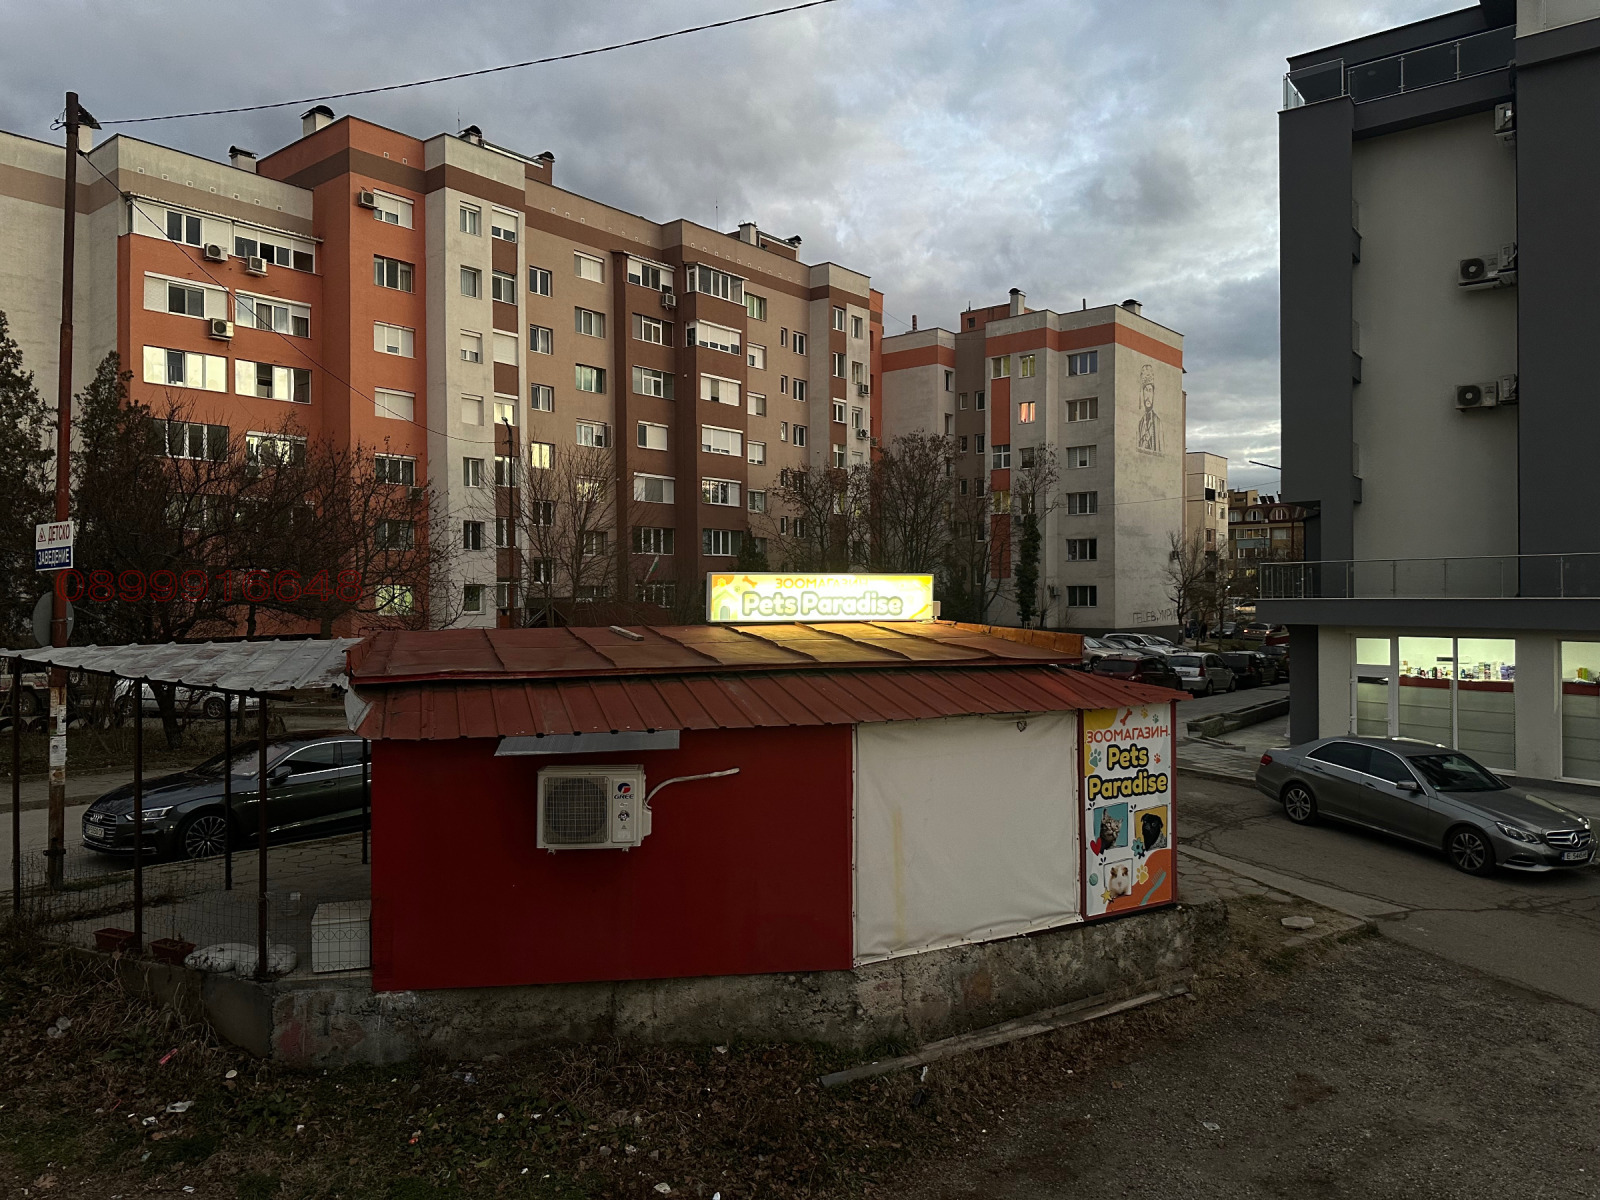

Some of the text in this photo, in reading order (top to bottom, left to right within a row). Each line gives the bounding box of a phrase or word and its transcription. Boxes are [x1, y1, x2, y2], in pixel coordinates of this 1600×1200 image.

[48, 524, 70, 544] ДЕТСКО
[38, 548, 70, 567] ЗАВЕДЕНИЕ
[776, 578, 868, 589] ЗООМАГАЗИН
[742, 591, 903, 616] Pets Paradise
[1087, 725, 1168, 744] ЗООМАГАЗИН
[1107, 744, 1148, 770] Pets
[1088, 769, 1168, 800] Paradise
